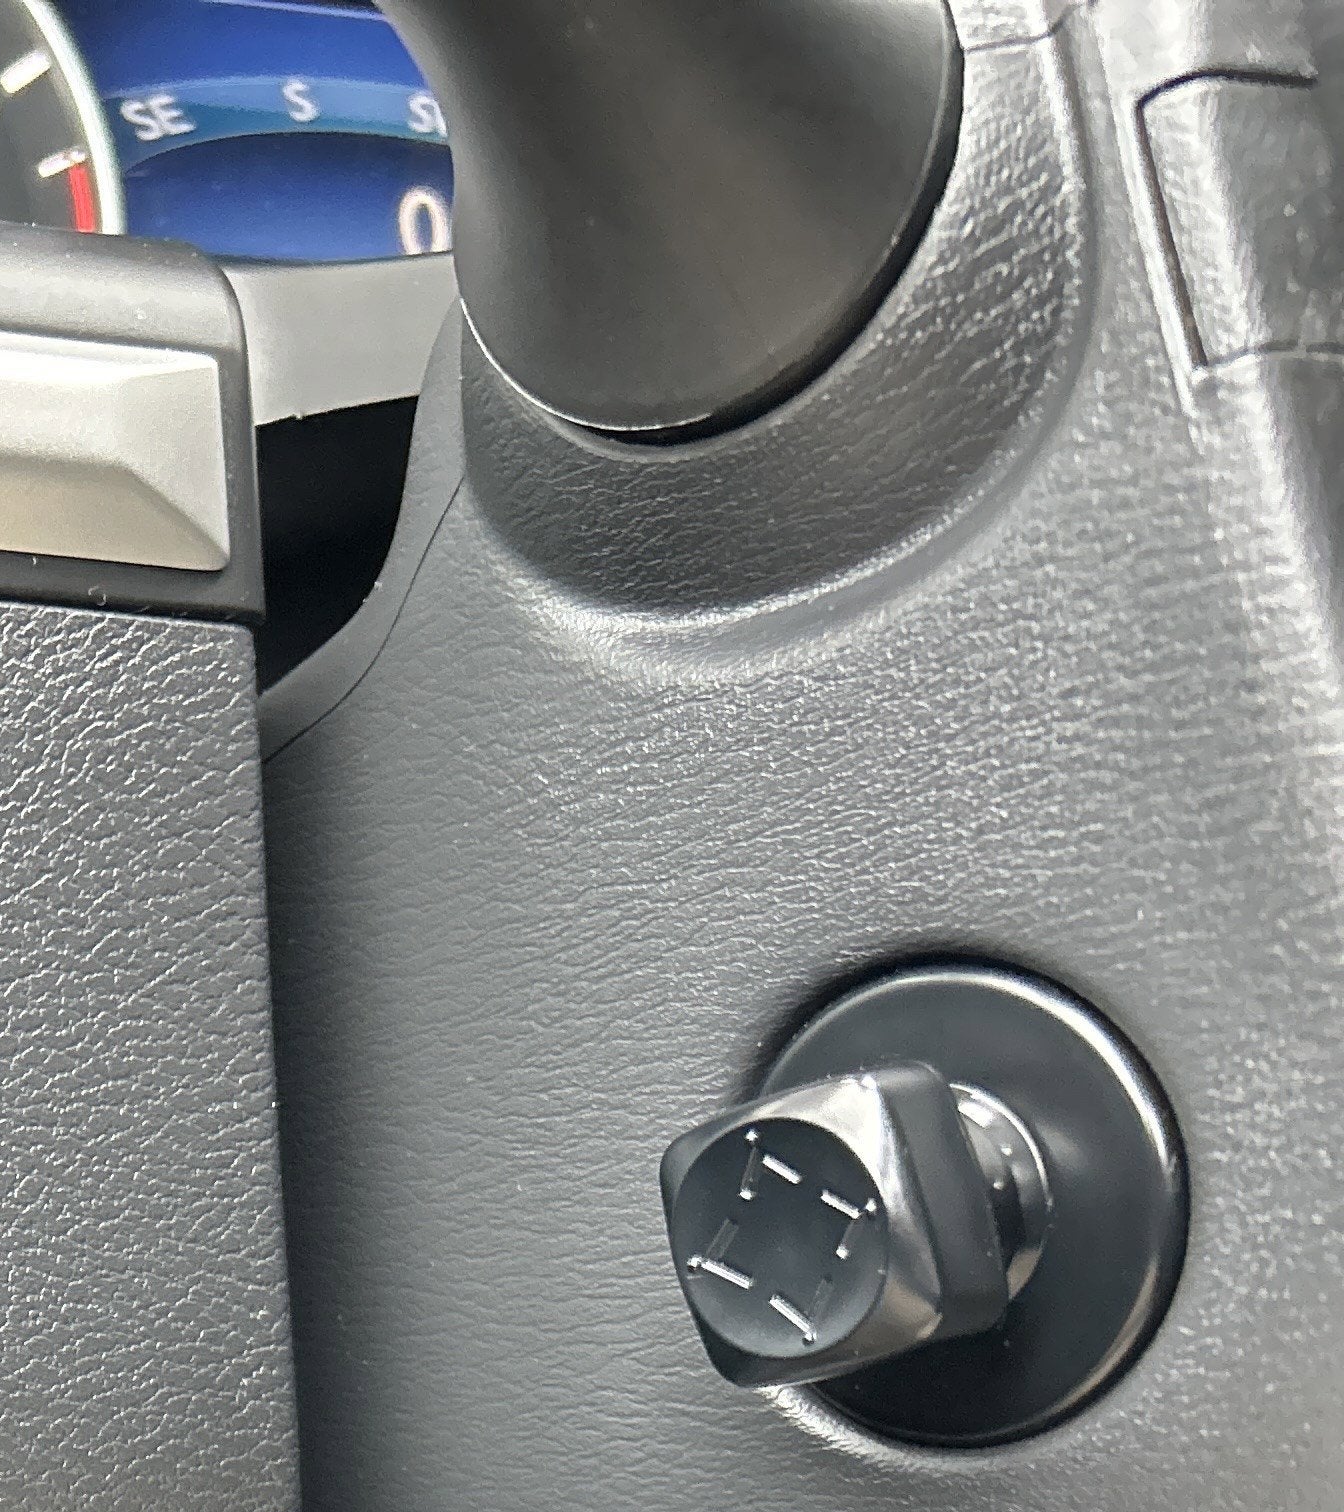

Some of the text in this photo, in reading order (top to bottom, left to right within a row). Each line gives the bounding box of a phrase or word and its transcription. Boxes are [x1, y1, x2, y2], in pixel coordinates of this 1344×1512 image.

[119, 79, 449, 141] SE S S
